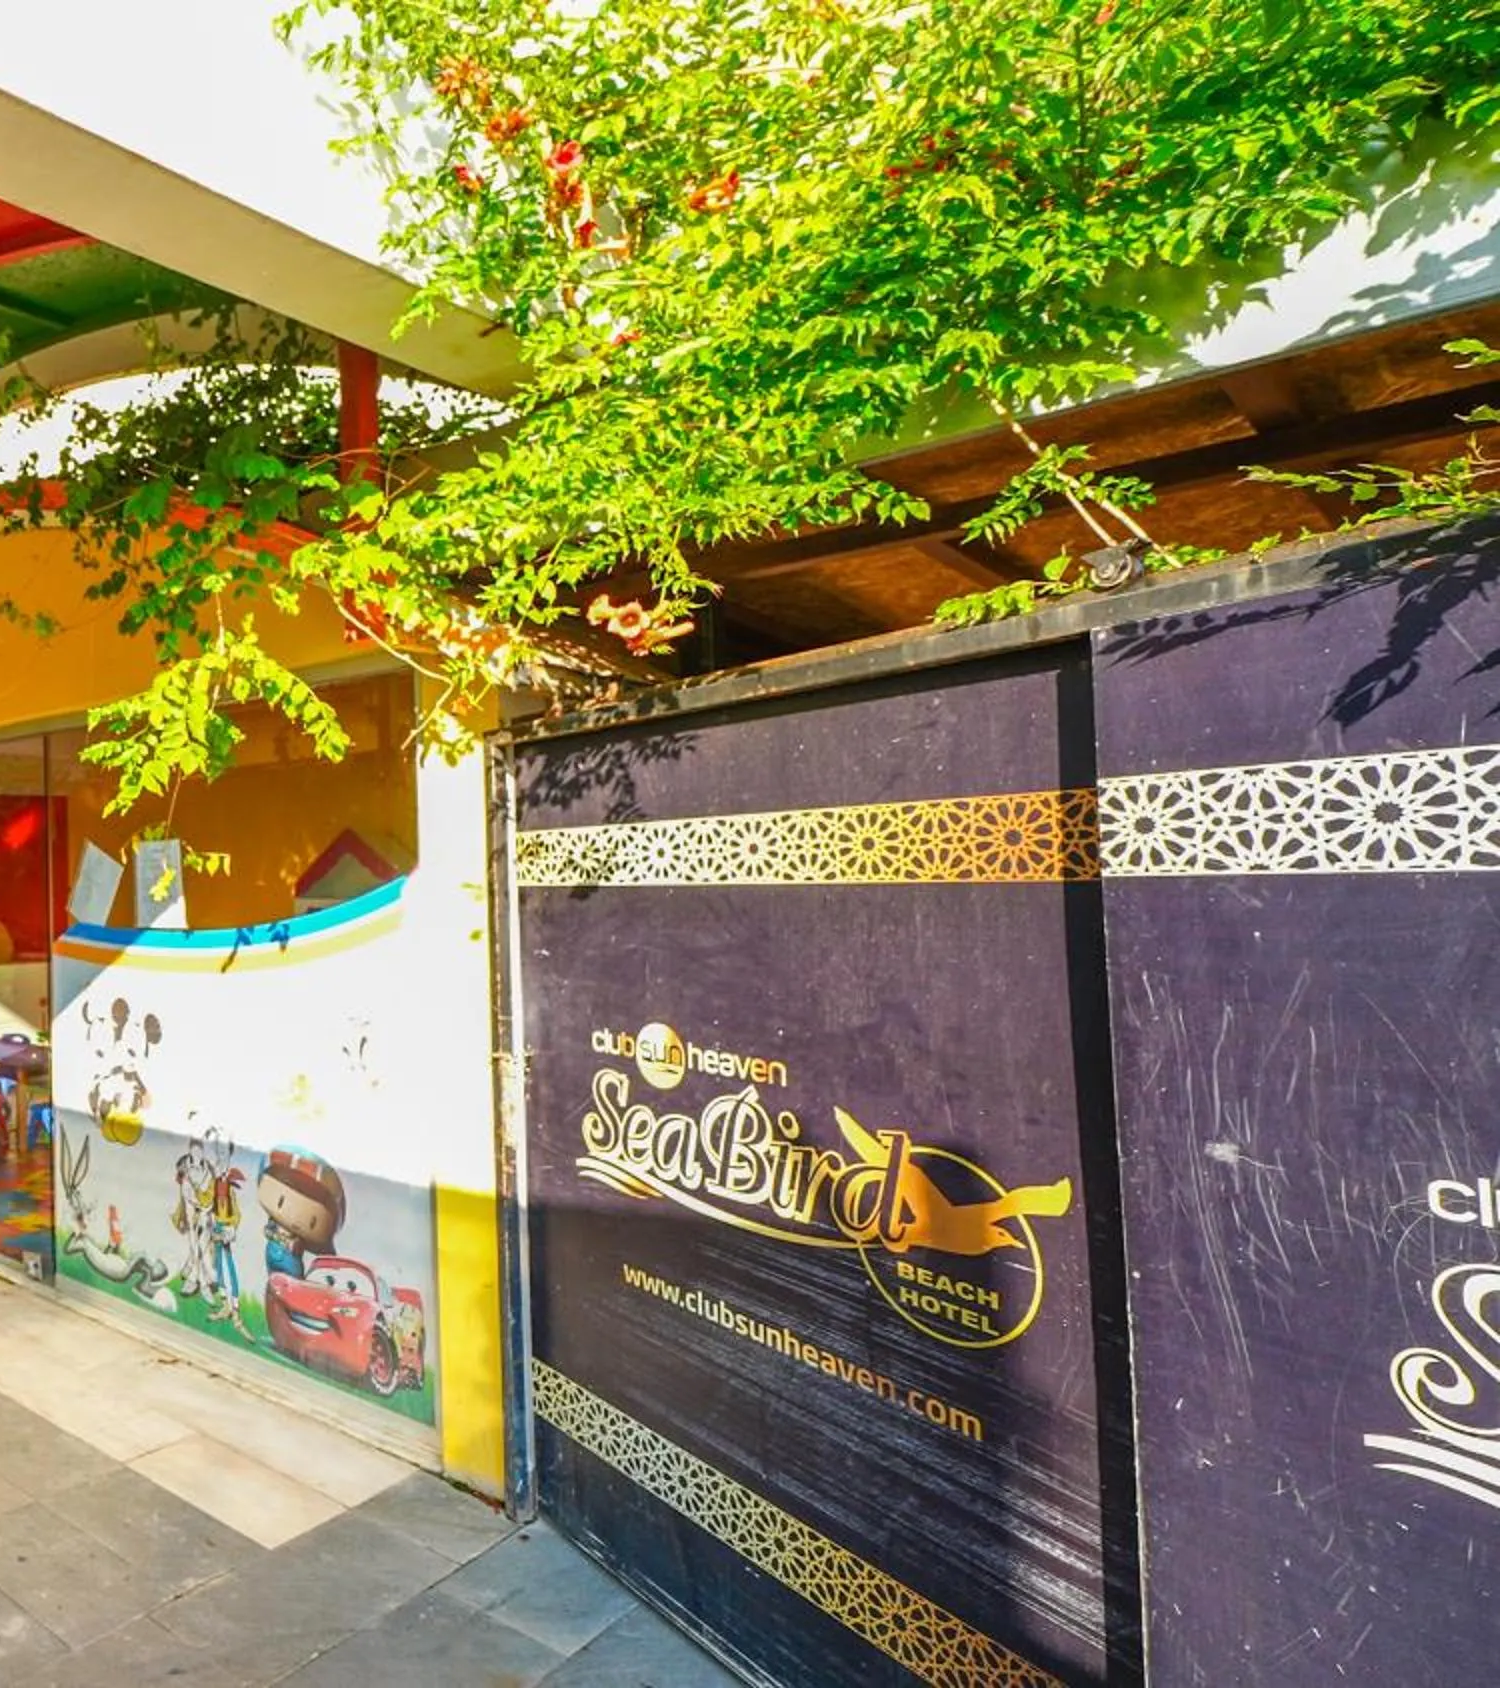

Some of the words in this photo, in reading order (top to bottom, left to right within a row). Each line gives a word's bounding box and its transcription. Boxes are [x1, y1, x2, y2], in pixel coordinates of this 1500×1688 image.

[687, 1041, 788, 1088] heaven
[896, 1261, 1000, 1311] BEACH
[899, 1286, 1000, 1337] HOTEL
[623, 1264, 984, 1442] www.clubsunheaven.com
